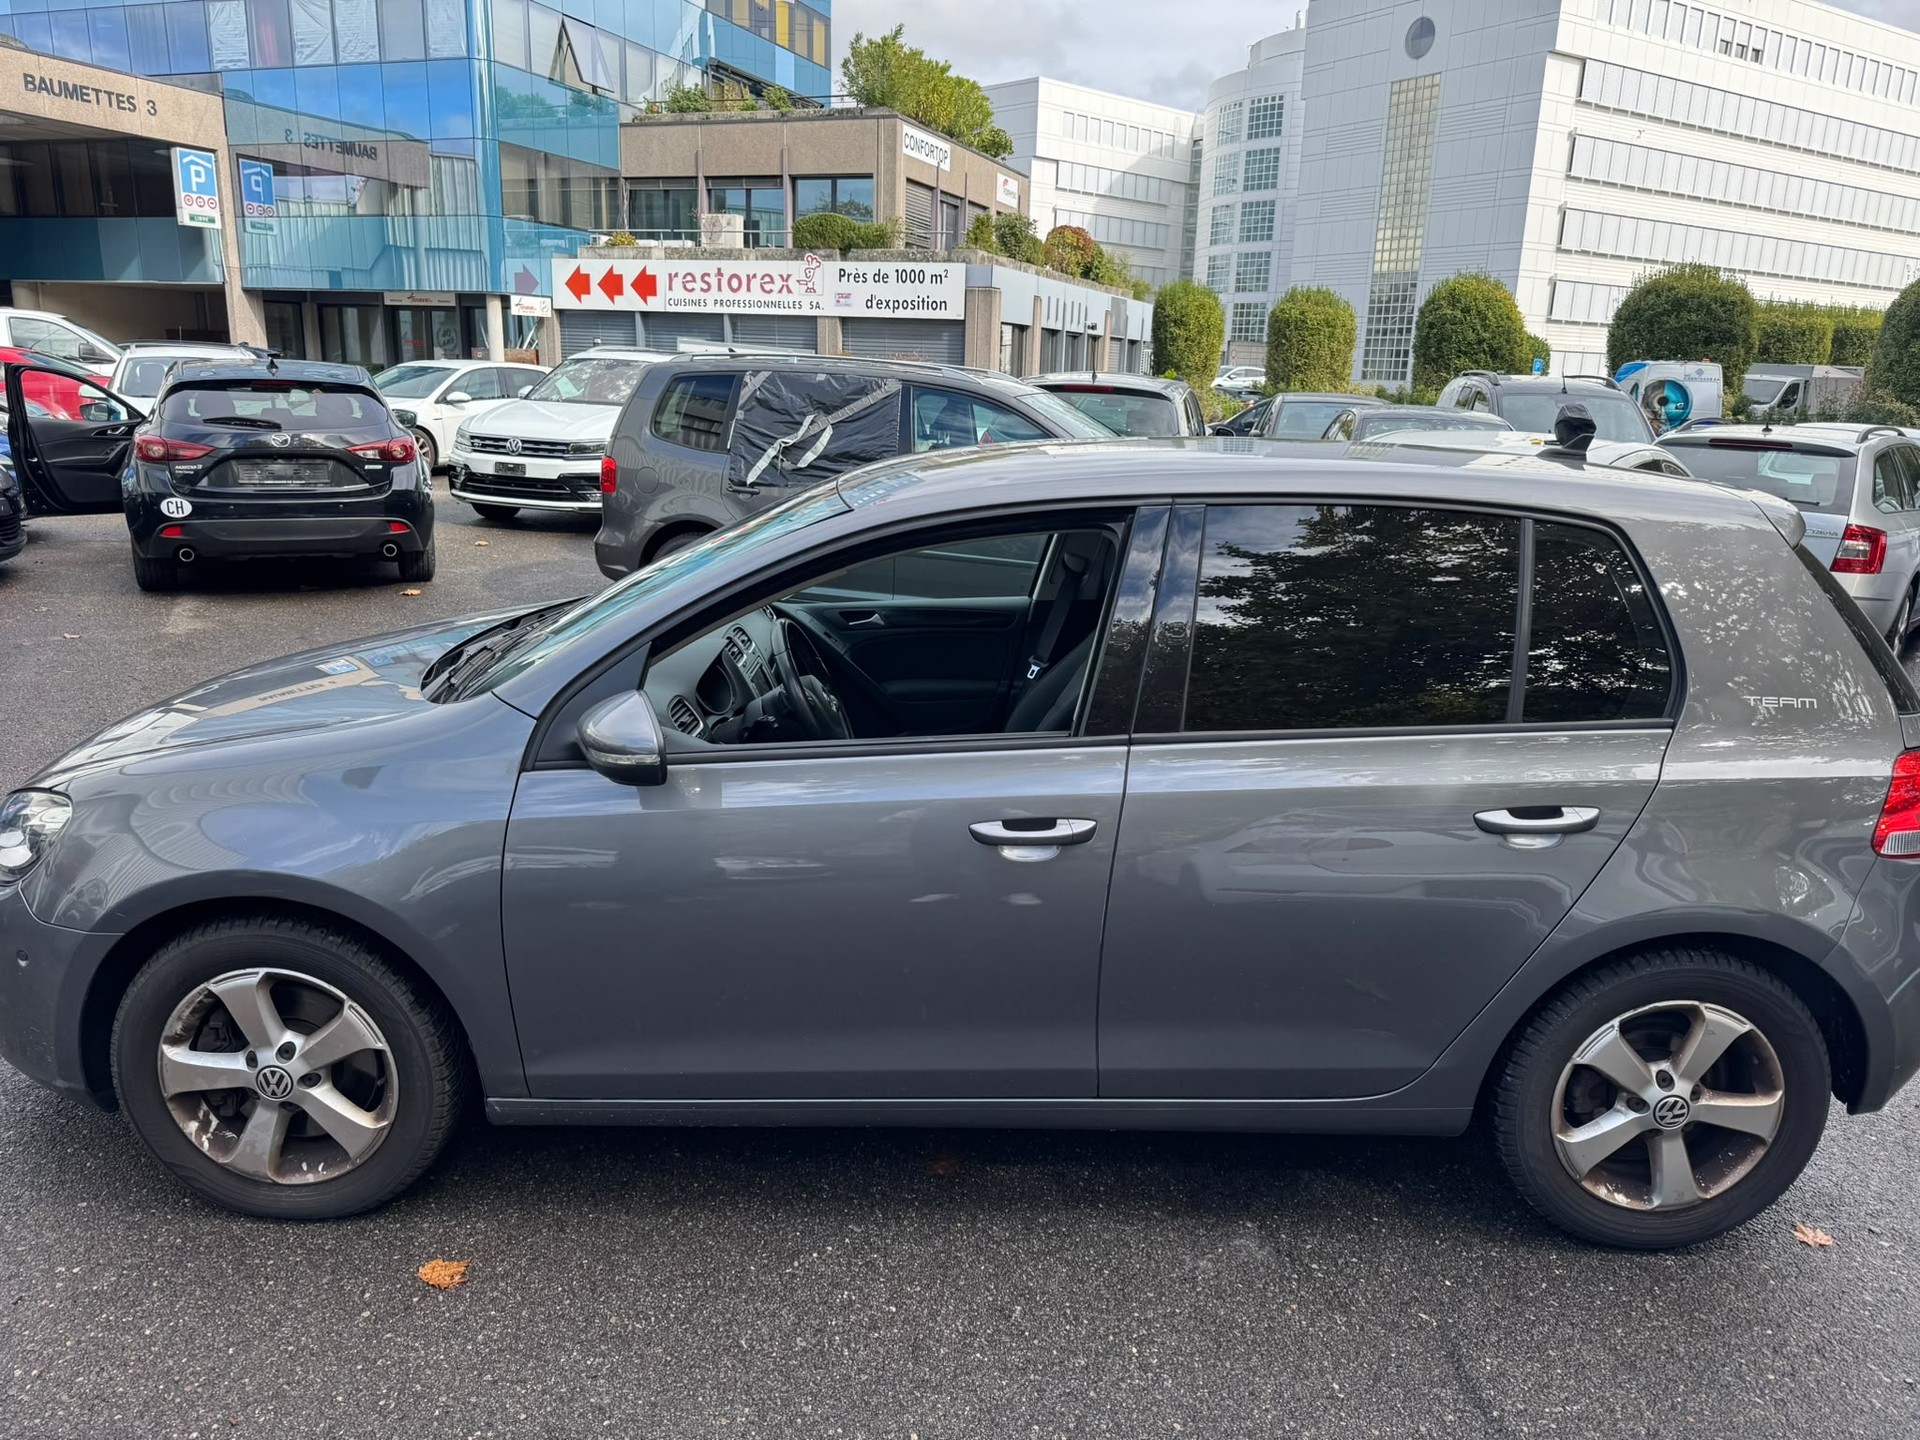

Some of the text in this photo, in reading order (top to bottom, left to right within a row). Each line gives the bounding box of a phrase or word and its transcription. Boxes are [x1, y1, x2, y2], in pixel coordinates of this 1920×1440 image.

[23, 73, 158, 116] BAUMETTES 3
[904, 133, 949, 165] CONFORTOP
[190, 165, 206, 192] P
[667, 267, 794, 294] restorex
[838, 267, 868, 283] Près
[872, 268, 889, 284] de
[895, 268, 926, 284] 1000
[667, 298, 825, 311] CUISINES PROFESSIONNELLES SA.
[865, 294, 948, 314] d'exposition
[166, 500, 185, 515] CH
[1743, 695, 1818, 709] TEAM
